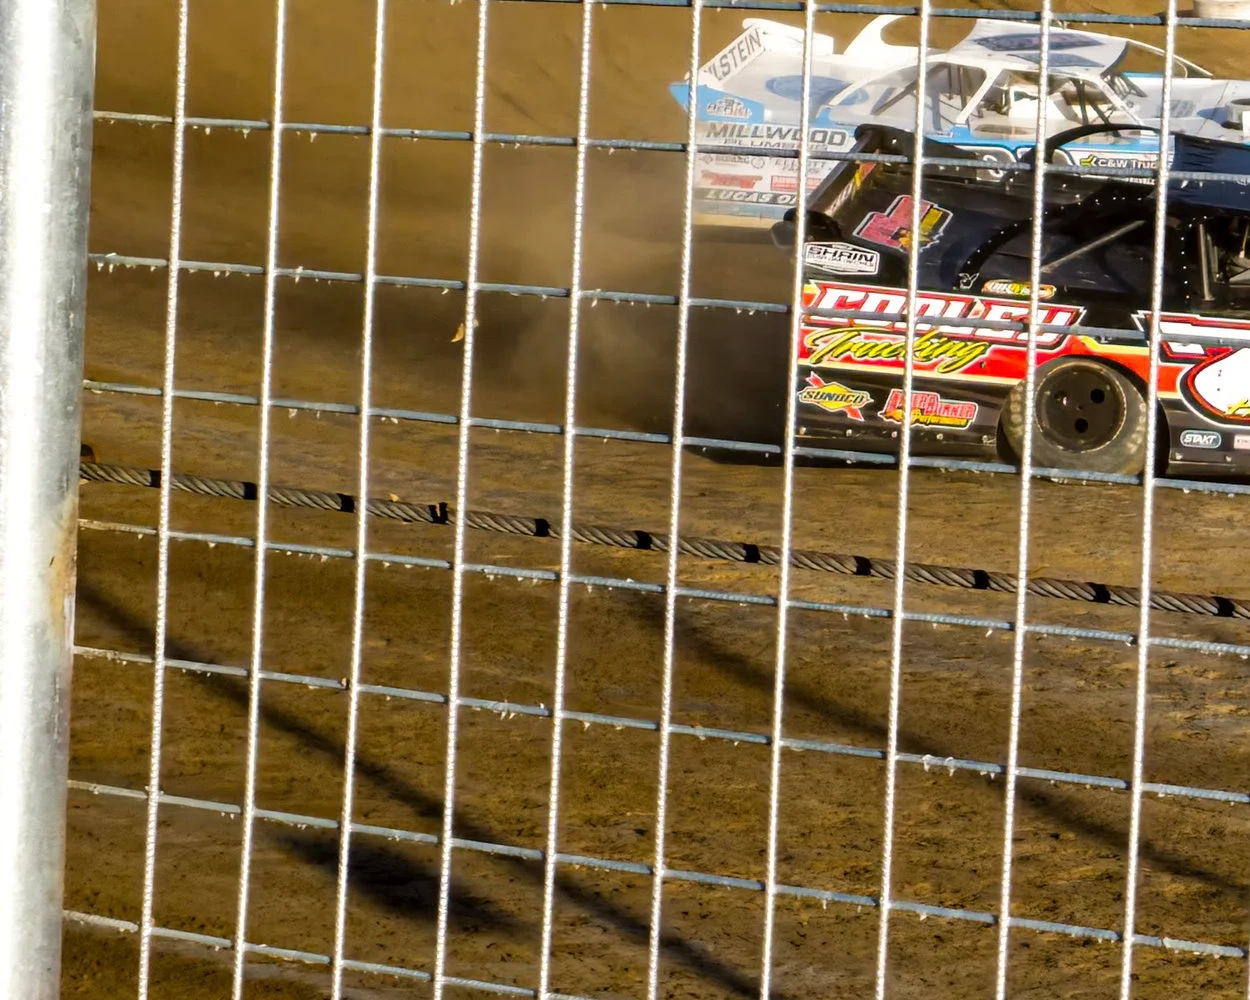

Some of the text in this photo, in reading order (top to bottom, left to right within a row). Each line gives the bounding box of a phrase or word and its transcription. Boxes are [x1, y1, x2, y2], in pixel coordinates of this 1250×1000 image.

[1098, 159, 1128, 169] C&W
[707, 189, 774, 204] LUCAS
[805, 326, 991, 373] Trucking
[803, 390, 864, 405] SUNOCO
